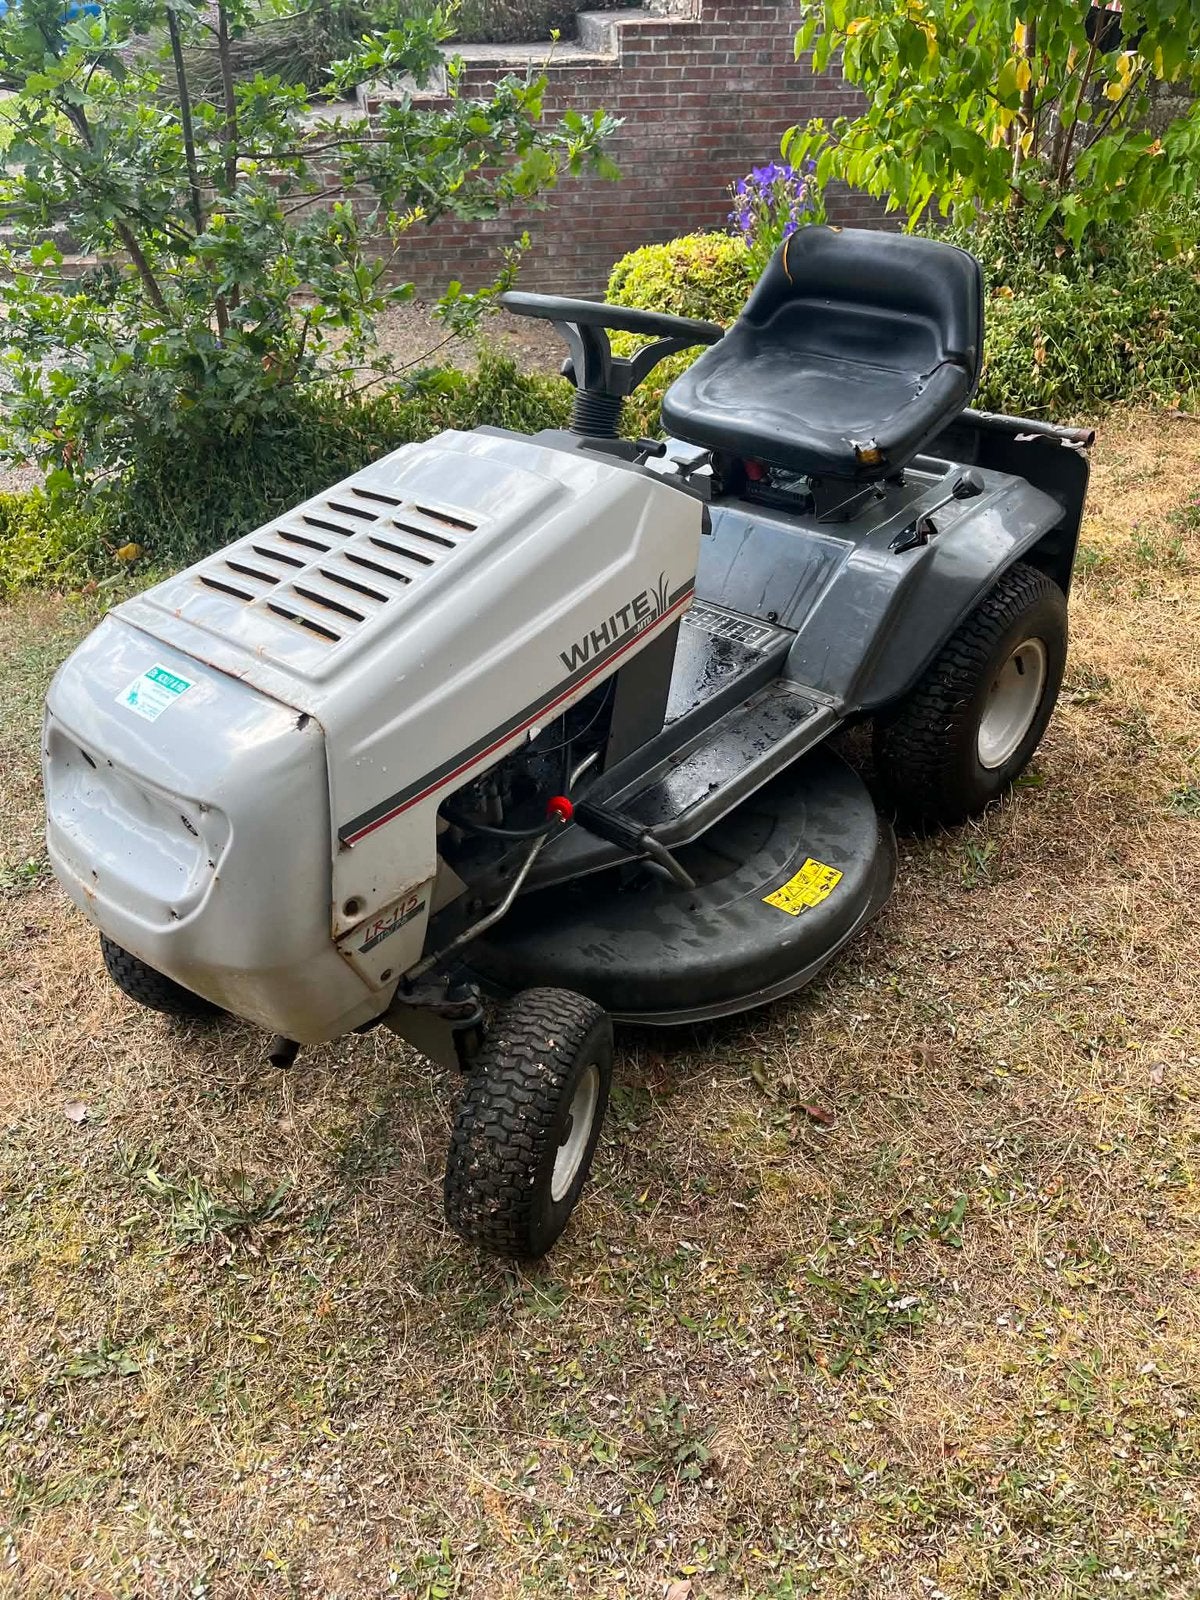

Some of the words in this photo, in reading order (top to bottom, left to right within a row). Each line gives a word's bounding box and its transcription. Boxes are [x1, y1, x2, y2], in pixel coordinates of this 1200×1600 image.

[559, 590, 651, 672] WHITE
[637, 616, 652, 633] MTD
[364, 894, 418, 943] LR-115
